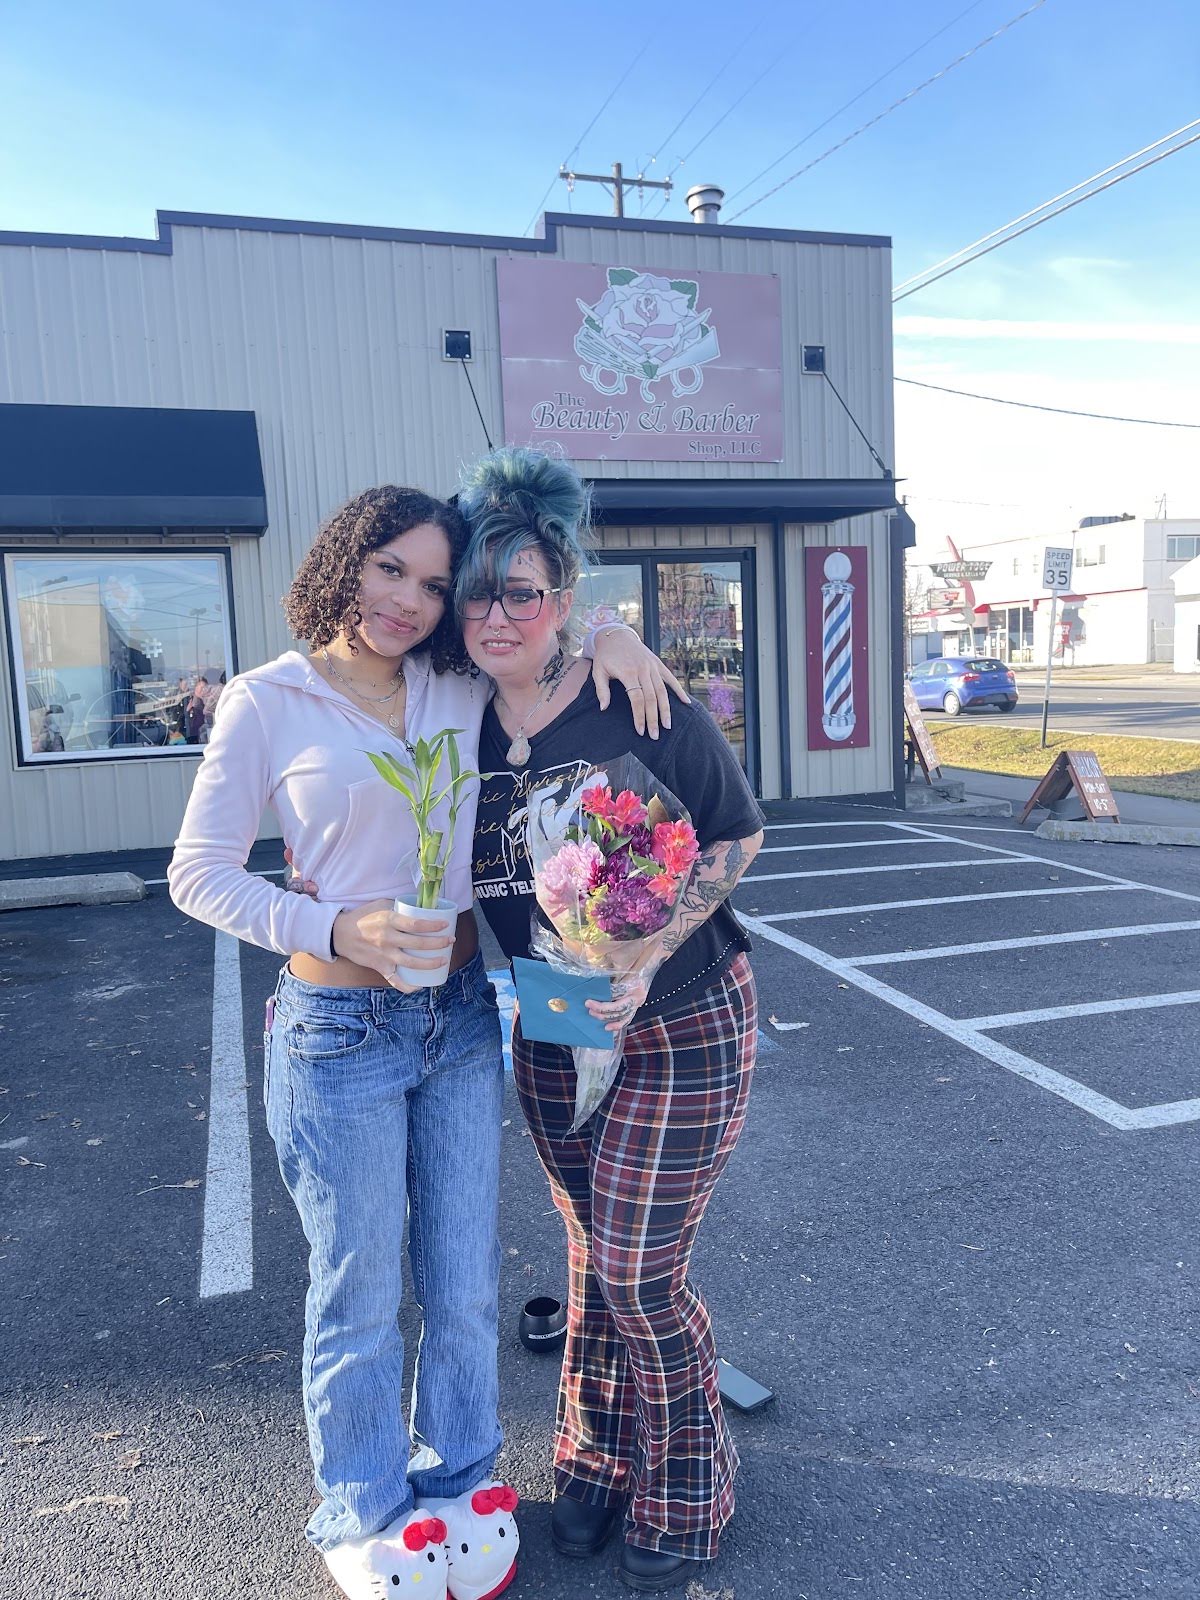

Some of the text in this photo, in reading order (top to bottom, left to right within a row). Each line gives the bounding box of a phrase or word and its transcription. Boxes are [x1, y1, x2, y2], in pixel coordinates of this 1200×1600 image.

[555, 392, 585, 407] The
[532, 401, 760, 440] Beauty & Barber
[688, 441, 761, 457] Shop, LLC
[1046, 551, 1071, 560] SPEED
[1048, 560, 1067, 568] LIMIT
[1045, 569, 1068, 585] 35
